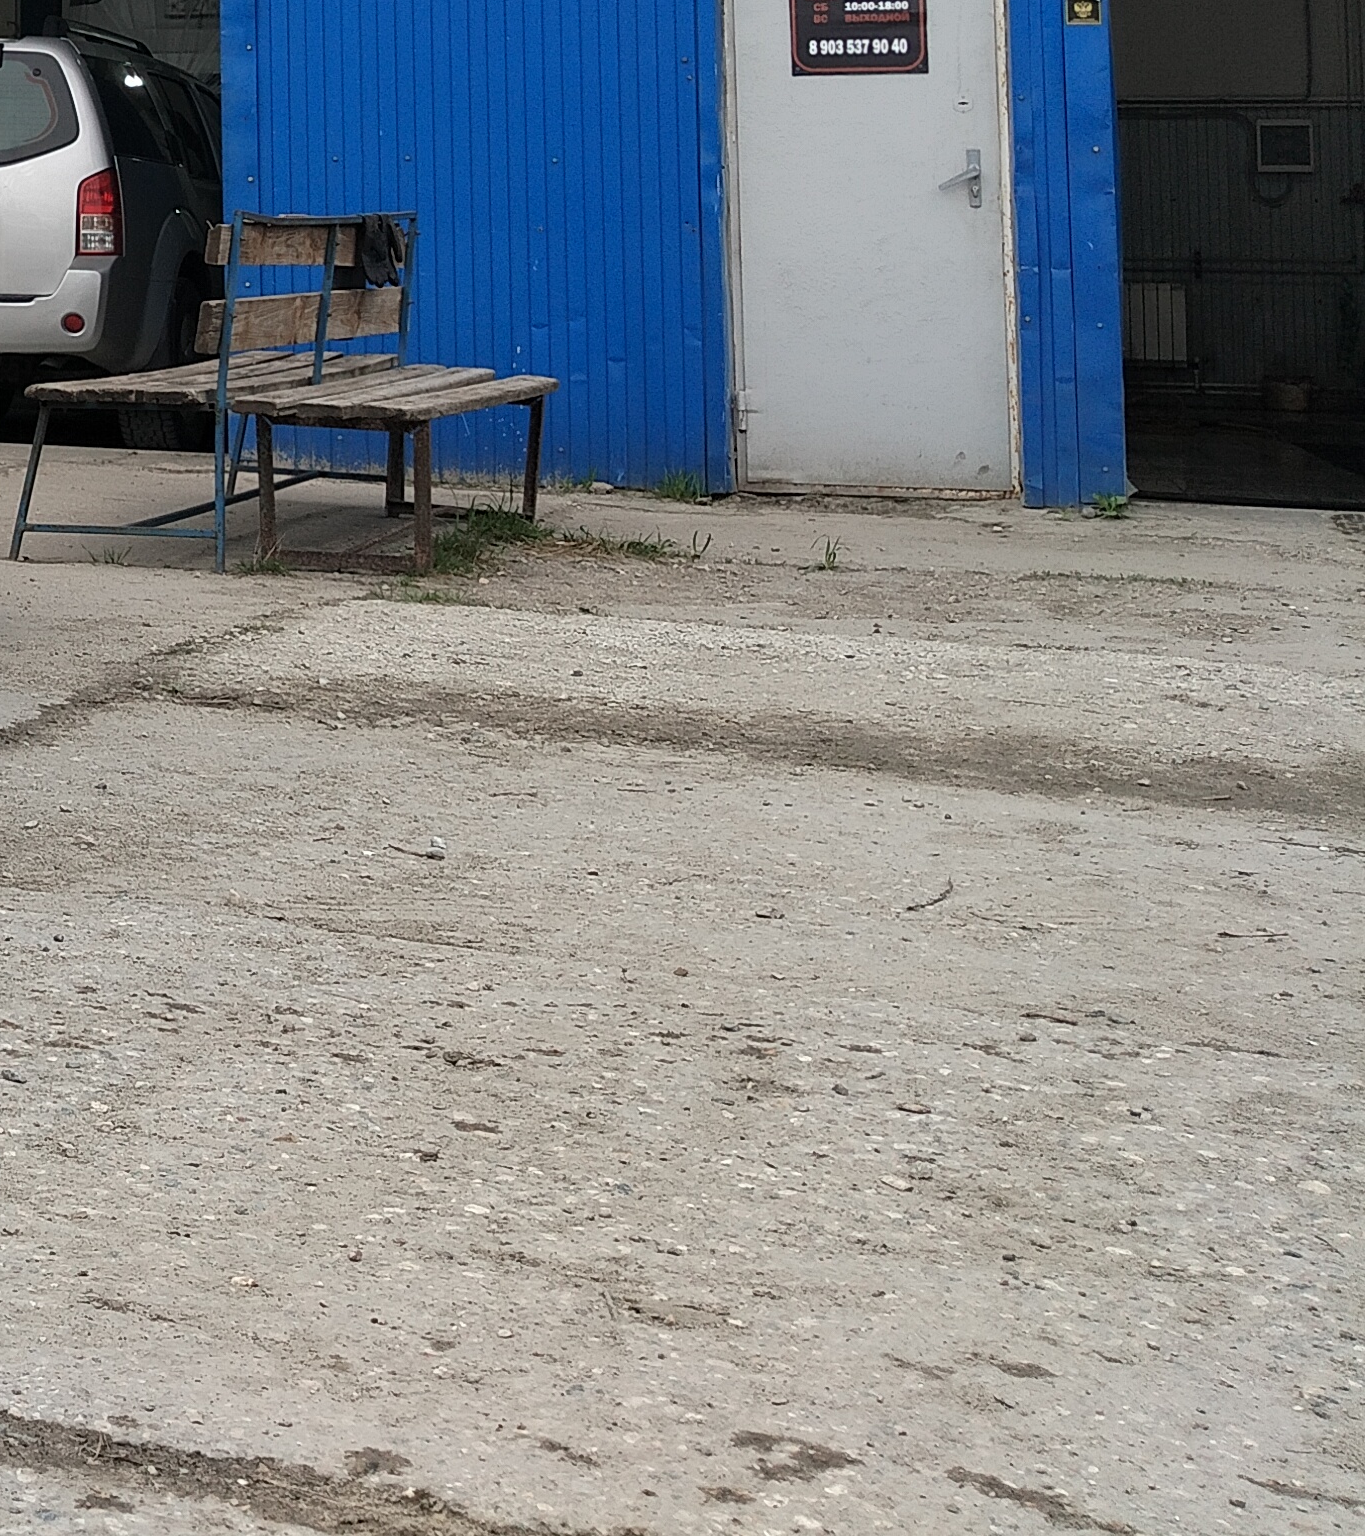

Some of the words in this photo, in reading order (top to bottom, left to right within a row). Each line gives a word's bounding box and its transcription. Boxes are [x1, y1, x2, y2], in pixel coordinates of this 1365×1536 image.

[813, 2, 829, 11] СБ
[844, 0, 909, 11] 10:00-18:00
[809, 39, 818, 55] 8
[819, 39, 844, 55] 903
[846, 38, 870, 55] 537
[872, 38, 889, 54] 90
[891, 37, 908, 54] 40
